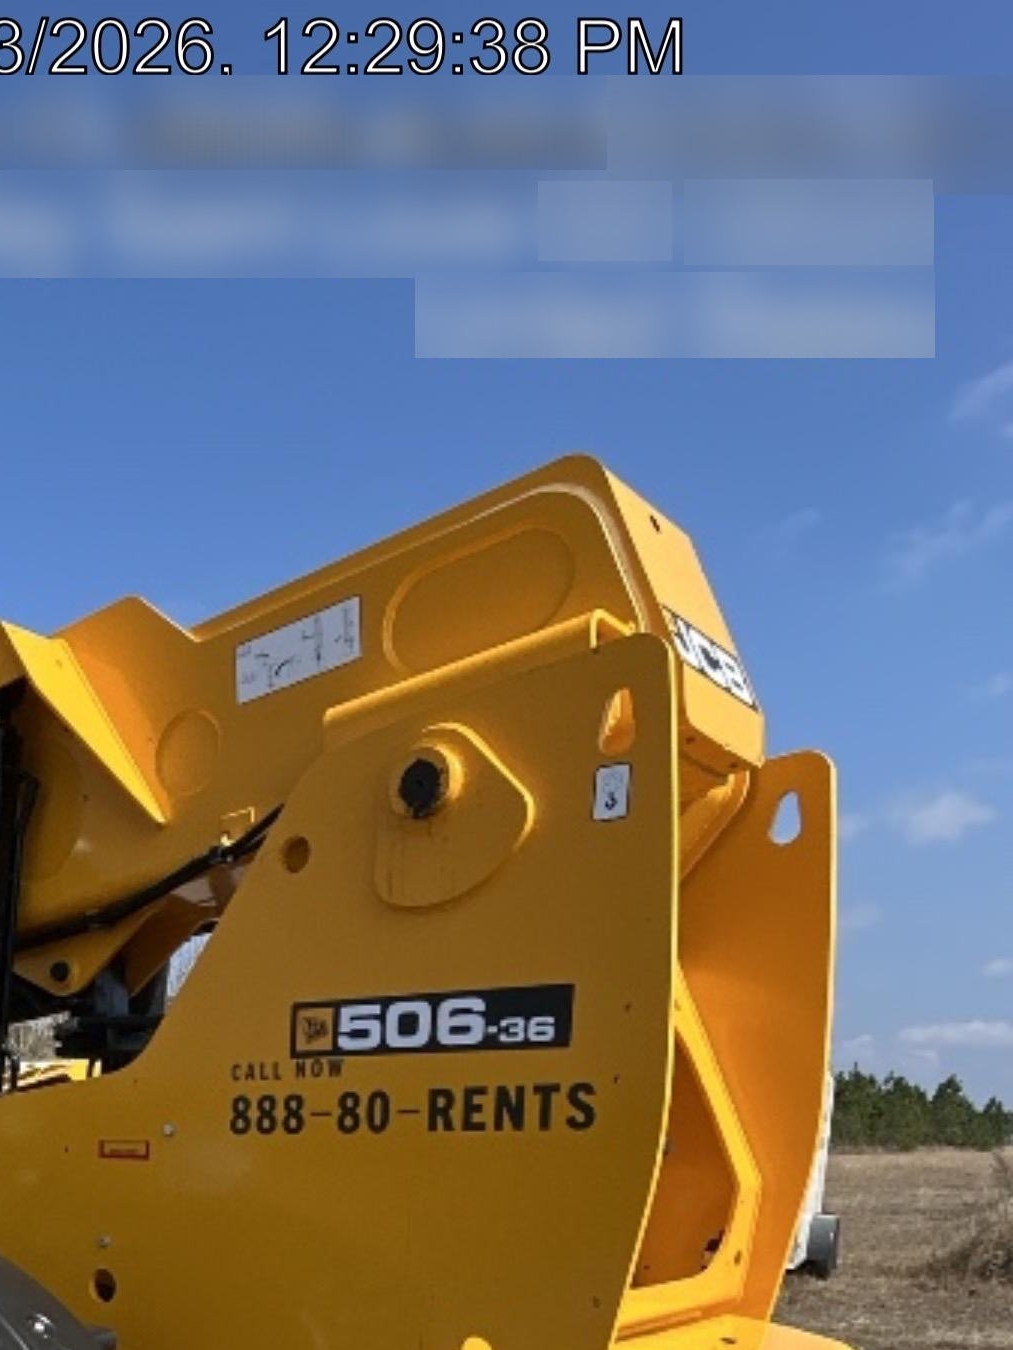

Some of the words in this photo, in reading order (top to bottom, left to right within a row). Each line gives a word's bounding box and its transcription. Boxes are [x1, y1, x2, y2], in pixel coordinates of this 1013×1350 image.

[338, 996, 556, 1050] 506-36
[231, 1061, 282, 1081] CALL
[295, 1058, 345, 1078] NOW
[230, 1081, 597, 1135] 888-80-RENTS
